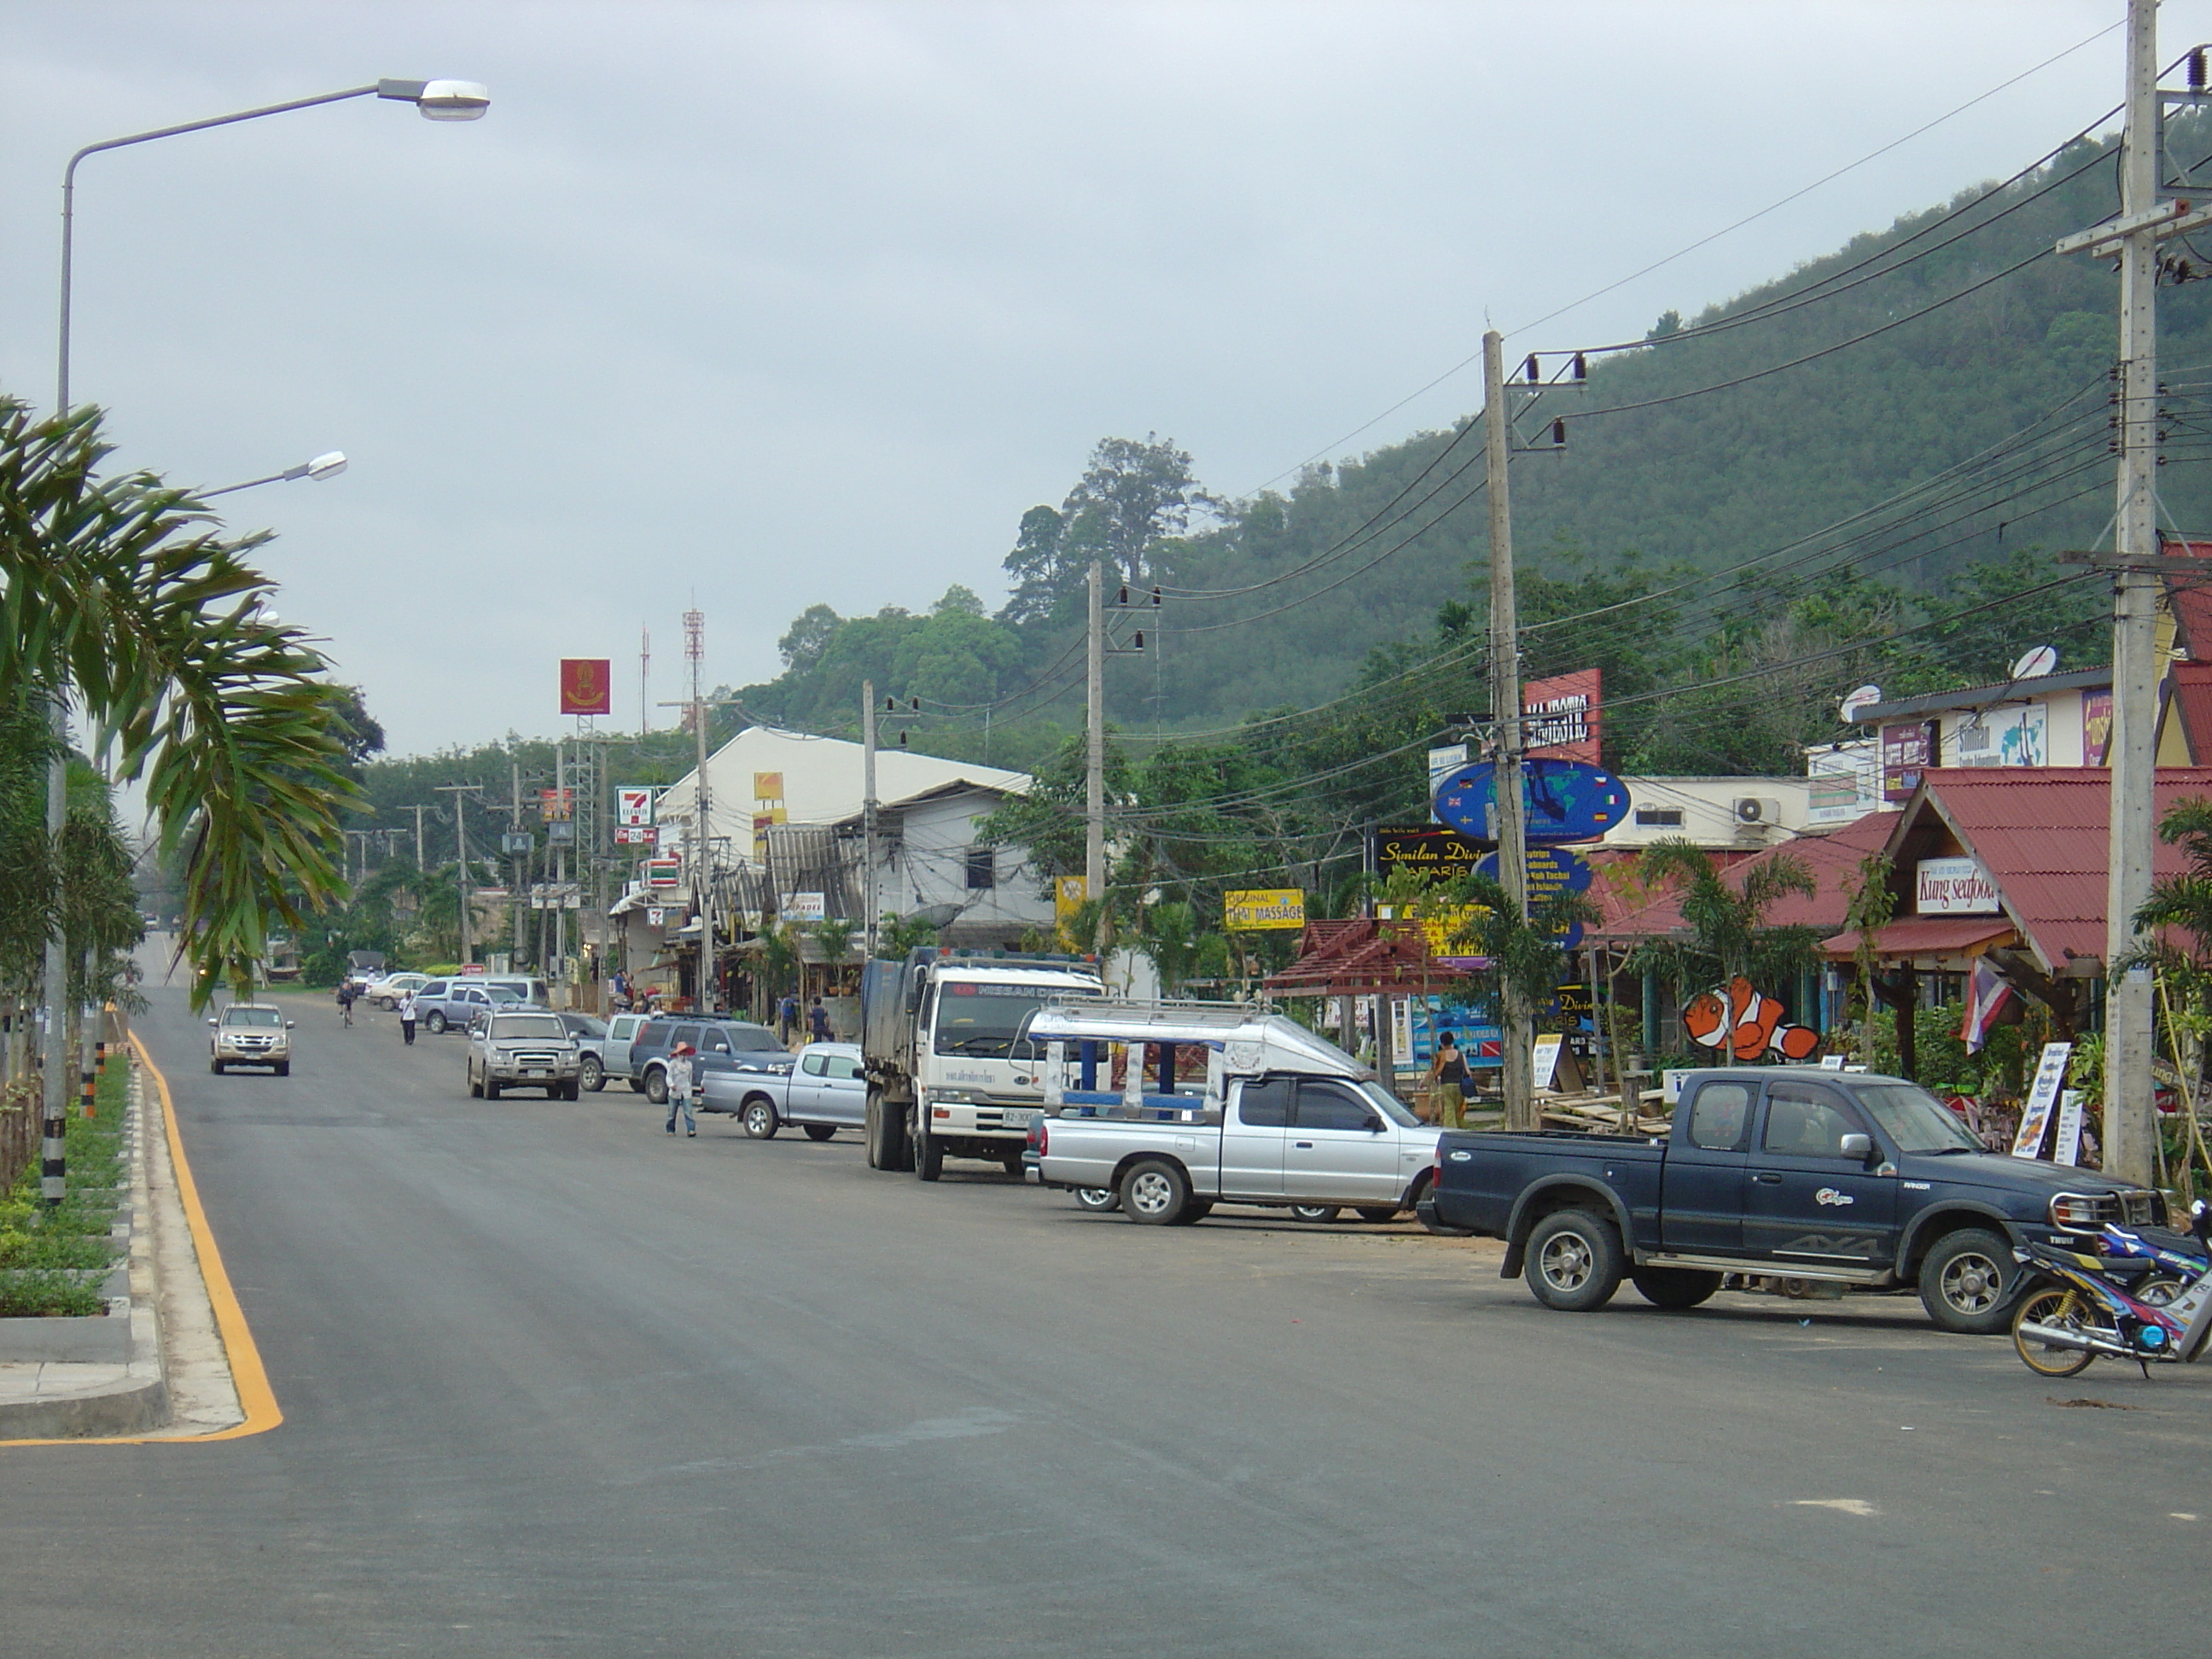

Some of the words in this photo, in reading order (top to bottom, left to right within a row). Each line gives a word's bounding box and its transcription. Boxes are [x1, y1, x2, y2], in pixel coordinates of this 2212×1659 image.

[624, 793, 647, 824] 7
[631, 831, 642, 841] 24
[1380, 841, 1438, 864] Similan
[1408, 865, 1467, 876] AFARIS
[1919, 870, 1949, 909] Kung
[1229, 894, 1270, 905] ORIGINAL
[1227, 906, 1250, 922] THAI
[1256, 905, 1302, 921] MASSAGE
[979, 985, 1035, 997] NISSAN
[2050, 1236, 2074, 1244] THULE
